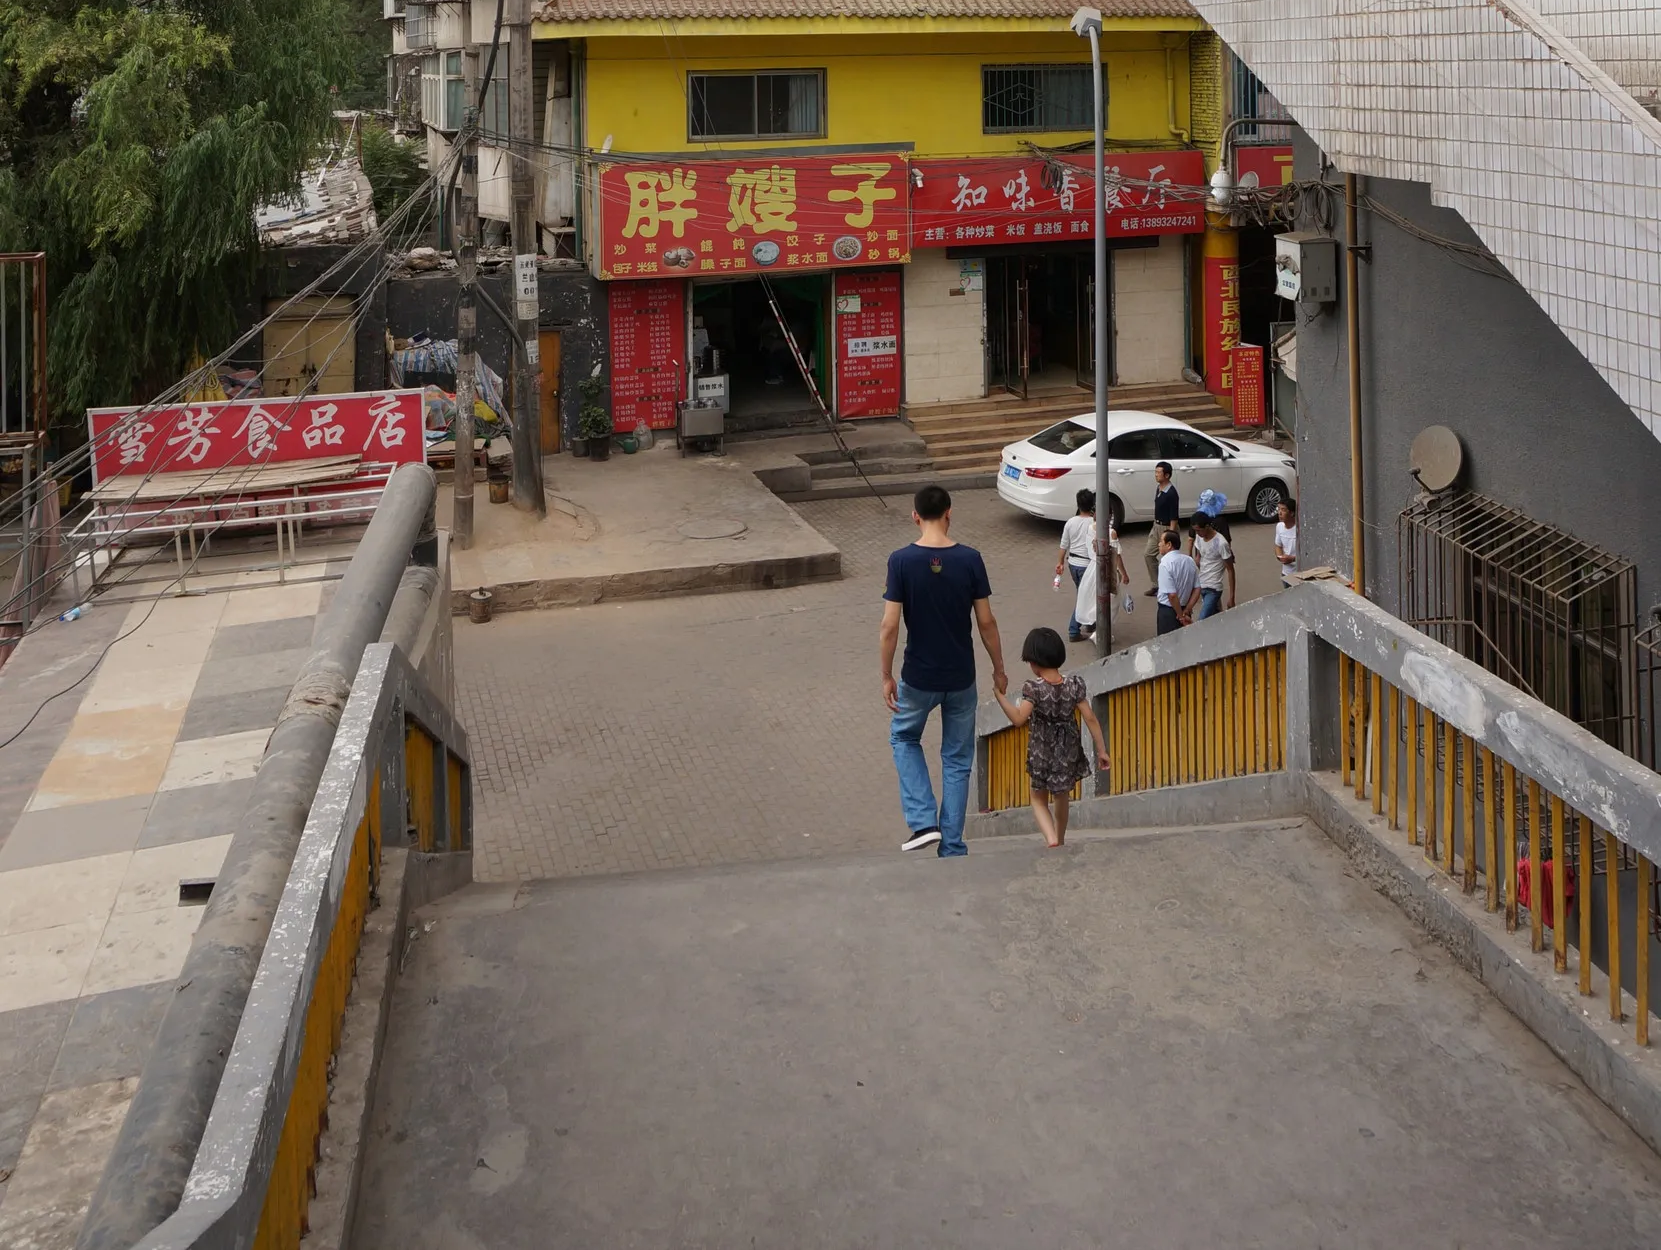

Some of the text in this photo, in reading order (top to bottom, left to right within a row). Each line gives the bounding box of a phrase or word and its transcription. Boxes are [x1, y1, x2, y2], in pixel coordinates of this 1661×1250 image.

[622, 162, 897, 238] 胖嫂子
[951, 164, 1172, 214] 知味香餐厅
[613, 229, 899, 256] 炒菜 馄饨 饺子 炒面
[954, 224, 995, 239] 各种炒菜
[1006, 223, 1026, 236] 米饭
[1033, 221, 1063, 235] 盖浇饭
[1070, 220, 1089, 233] 面食
[612, 247, 900, 274] 包子 米线 臊子面 浆水面 砂锅
[872, 340, 896, 350] 浆水面
[108, 395, 406, 465] 雪芳食品店
